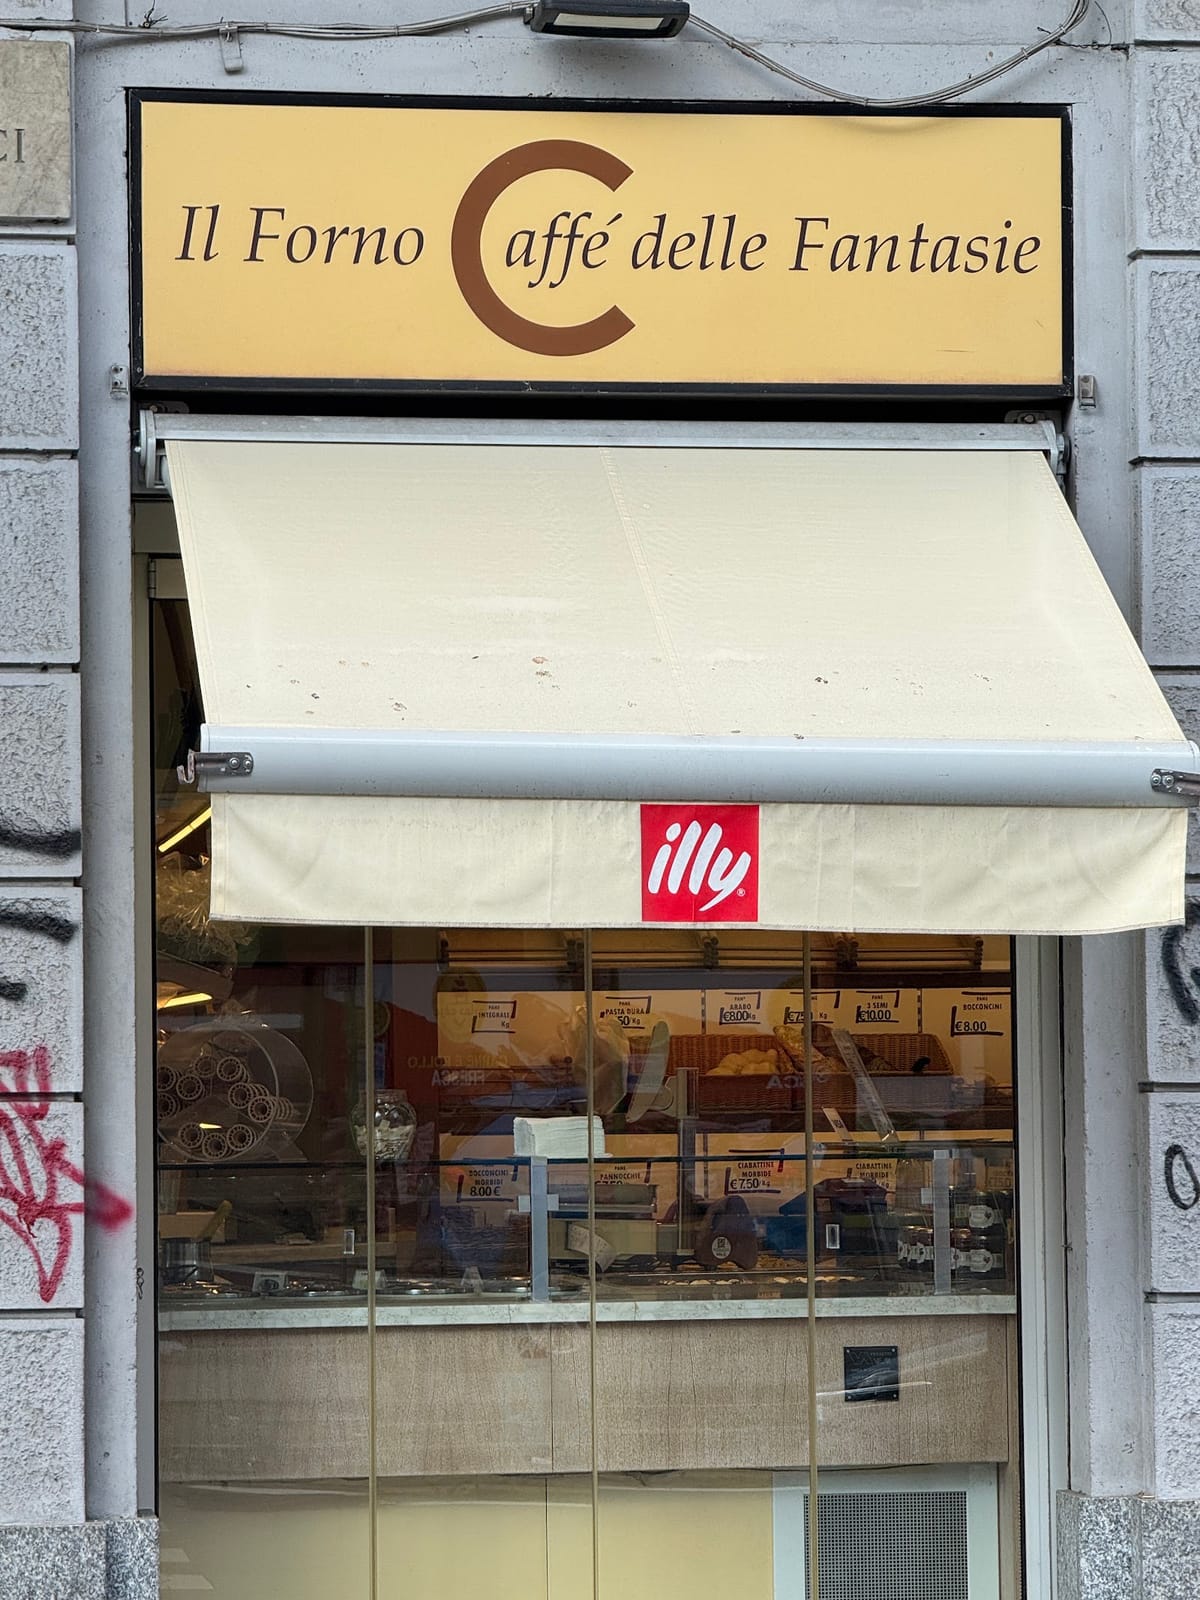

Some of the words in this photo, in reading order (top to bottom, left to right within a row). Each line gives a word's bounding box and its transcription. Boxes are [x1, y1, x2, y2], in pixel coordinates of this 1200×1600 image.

[0, 128, 25, 163] I
[174, 204, 219, 261] Il
[243, 206, 425, 266] Forno
[631, 213, 768, 271] delle
[788, 215, 1041, 274] Fantasie
[647, 820, 752, 912] illy
[600, 1172, 640, 1180] PANNOCCHIE
[742, 1170, 772, 1178] MORBIDE
[856, 1162, 892, 1170] CIABATTINE
